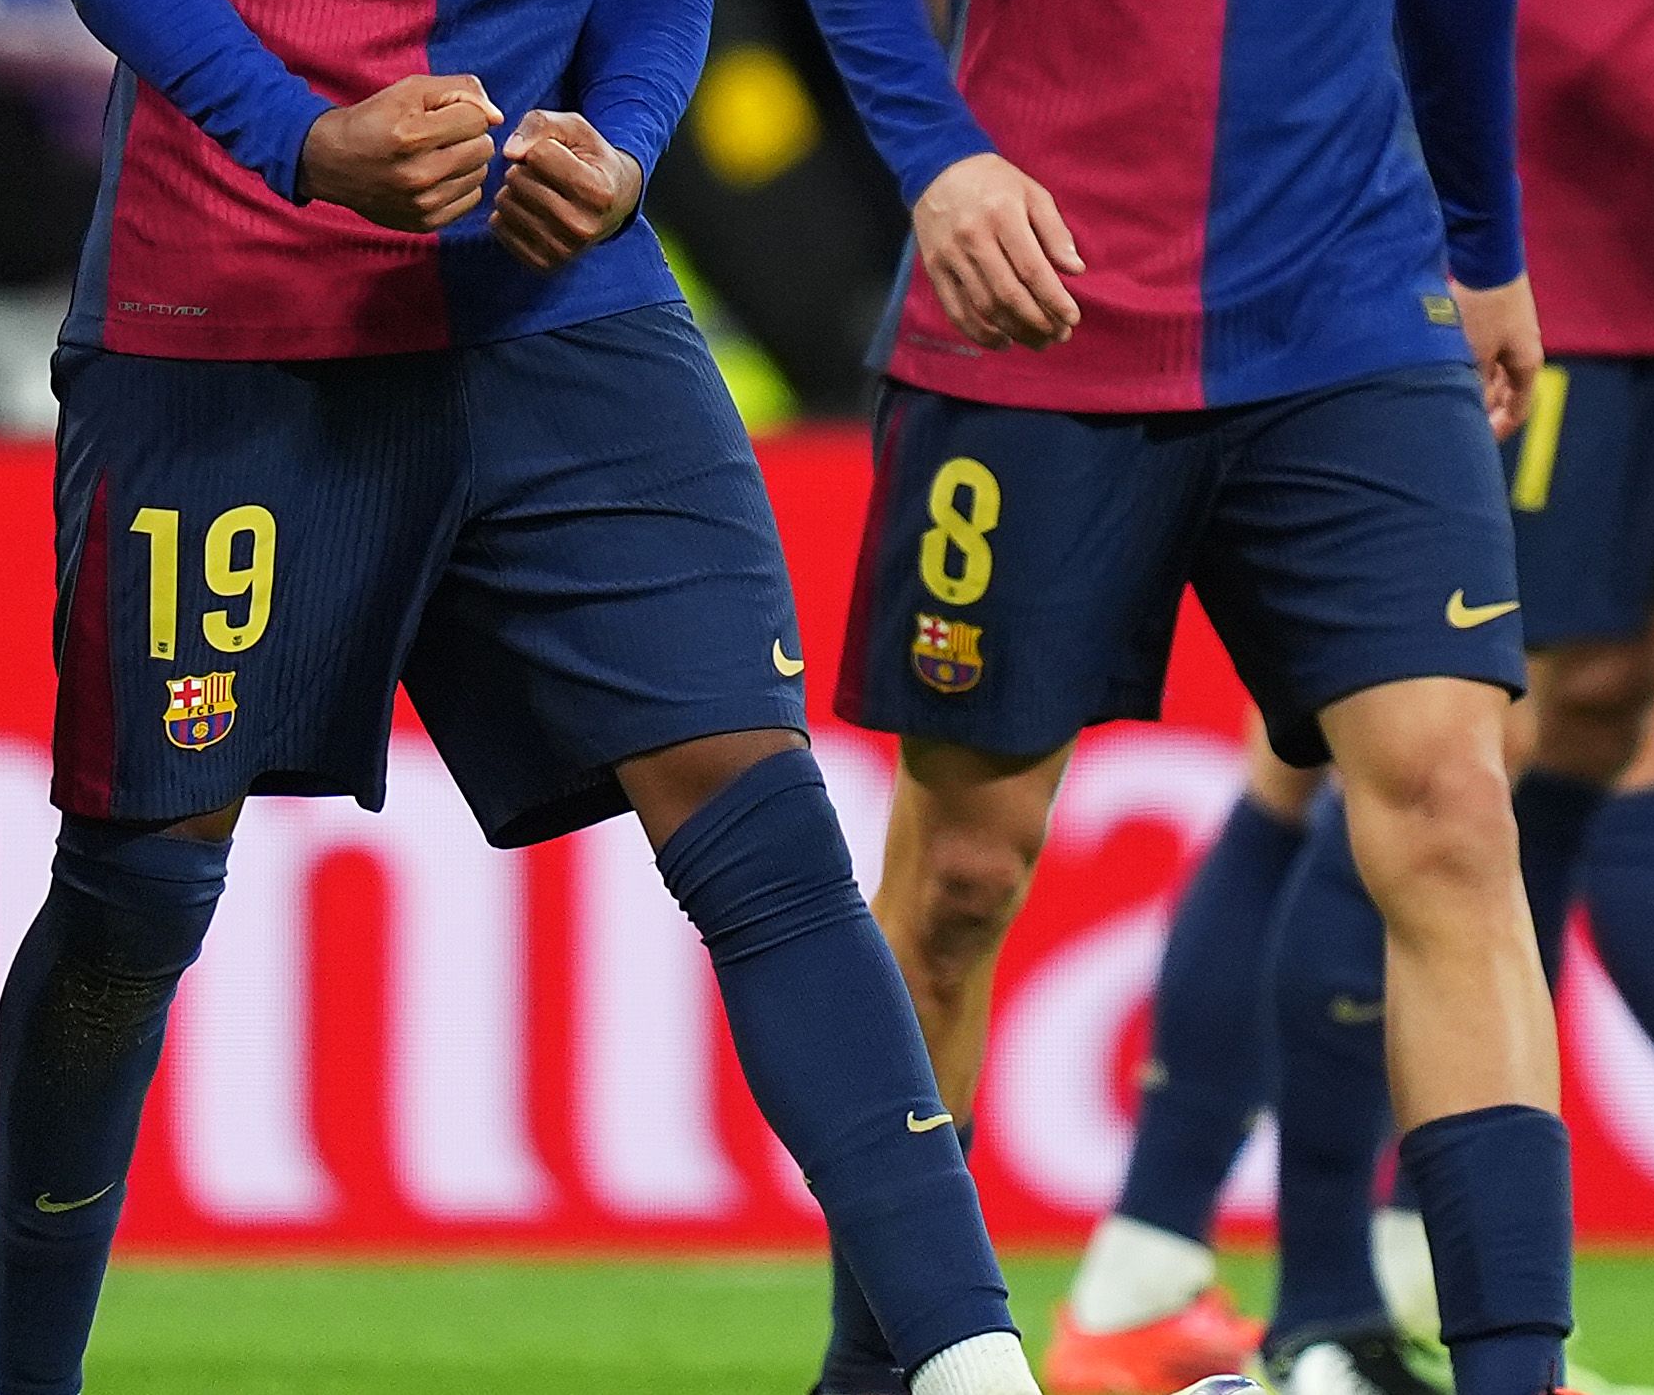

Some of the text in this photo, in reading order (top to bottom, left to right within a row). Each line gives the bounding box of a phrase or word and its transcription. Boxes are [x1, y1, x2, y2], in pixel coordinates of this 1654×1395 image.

[129, 504, 278, 662] 19
[919, 457, 1002, 606] 8
[187, 704, 215, 718] FCB
